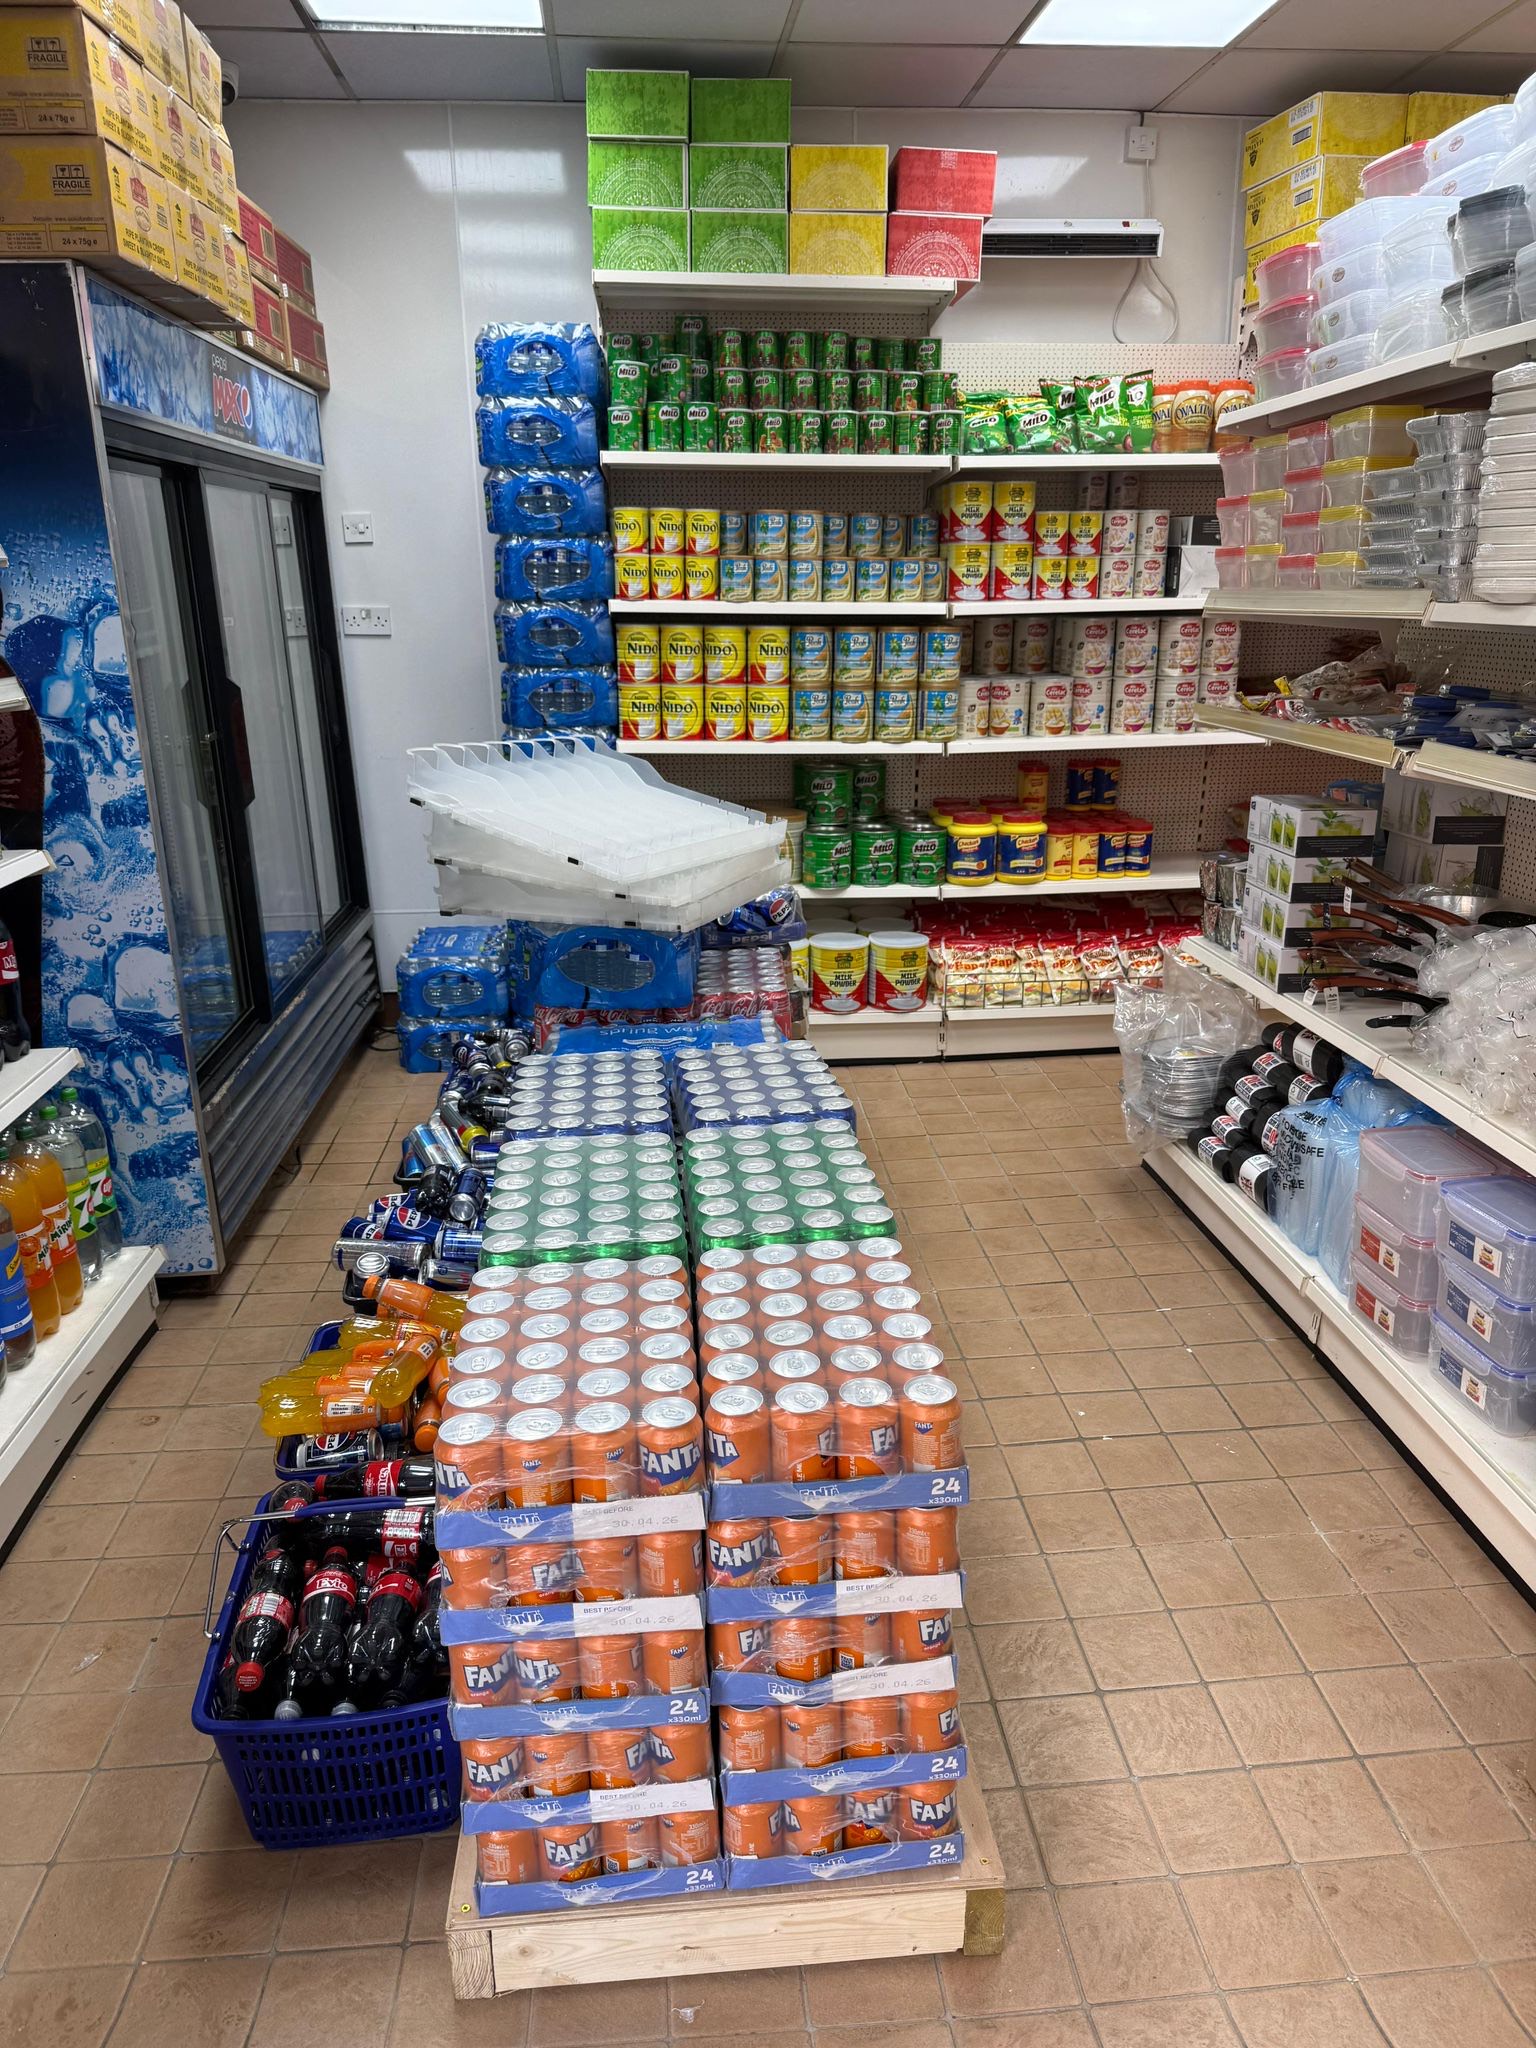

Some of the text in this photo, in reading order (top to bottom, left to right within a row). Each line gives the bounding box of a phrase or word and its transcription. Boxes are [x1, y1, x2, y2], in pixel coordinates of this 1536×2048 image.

[28, 53, 66, 62] FRAGILE
[53, 180, 90, 188] FRAGILE
[79, 238, 92, 246] 75g
[1089, 389, 1115, 408] MILO
[1176, 404, 1213, 420] OVALTIN
[1023, 414, 1048, 427] MILO
[659, 521, 682, 531] NIDO
[691, 522, 716, 532] NIDO
[623, 567, 647, 577] NIDO
[653, 568, 678, 577] NIDO
[628, 643, 658, 655] NIDO
[669, 643, 700, 655] NIDO
[759, 644, 788, 656] NIDO
[632, 701, 661, 713] NIDO
[663, 701, 693, 713] NIDO
[710, 702, 741, 713] NIDO
[749, 701, 780, 713] NIDO
[856, 775, 877, 785] MILO
[812, 782, 833, 791] MILO
[873, 844, 893, 855] MILO
[914, 843, 936, 853] MILO
[732, 932, 773, 944] PEPSI
[915, 1422, 933, 1430] FANTA
[606, 1448, 624, 1460] FANTA
[640, 1444, 701, 1476] FANTA
[931, 1478, 961, 1495] 24
[928, 1496, 962, 1505] x330ml
[603, 1505, 634, 1514] BEFORE
[612, 1516, 679, 1528] 30.04.26
[316, 1578, 348, 1591] Evie
[767, 1591, 807, 1602] FANTA
[874, 1594, 938, 1604] 30.04.26
[502, 1611, 544, 1627] FANTA
[610, 1615, 675, 1626] 30.04.26
[670, 1645, 688, 1655] FANTA
[860, 1671, 888, 1680] BEFORE
[768, 1683, 805, 1696] FANTA
[869, 1678, 932, 1690] 30.04.26
[670, 1699, 699, 1714] 24
[667, 1715, 701, 1723] x330ml
[931, 1756, 959, 1772] 24
[928, 1771, 960, 1780] x330ml
[626, 1801, 688, 1811] 30.04.26
[929, 1842, 956, 1857] 24
[927, 1856, 958, 1865] x330ml
[687, 1868, 714, 1885] 24
[684, 1882, 717, 1892] x330ml
